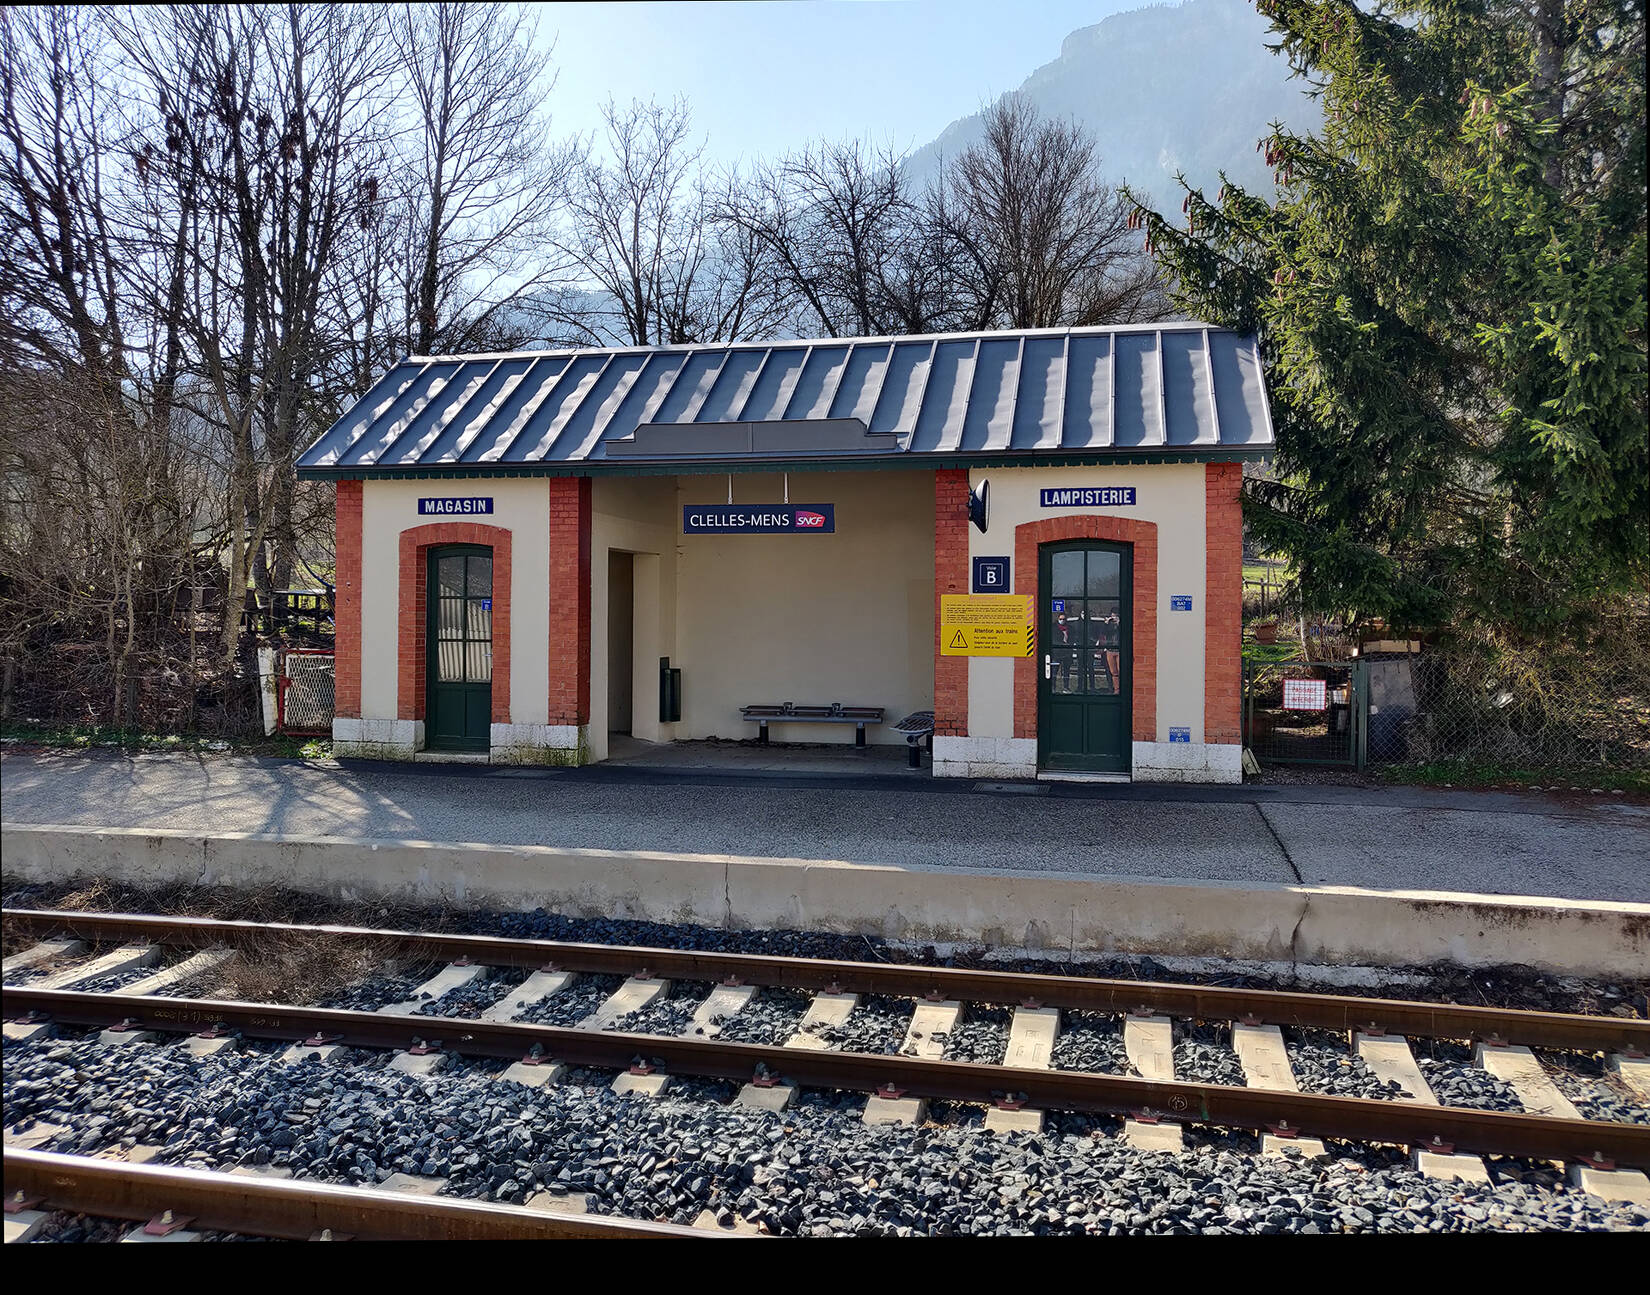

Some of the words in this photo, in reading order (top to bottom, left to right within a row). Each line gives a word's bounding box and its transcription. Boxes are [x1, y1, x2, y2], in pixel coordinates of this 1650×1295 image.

[1044, 490, 1132, 505] LAMPISTERIE
[425, 500, 486, 513] MAGASIN
[690, 514, 790, 527] CLELLES-MENS
[796, 516, 824, 526] SNCF
[987, 571, 996, 584] B
